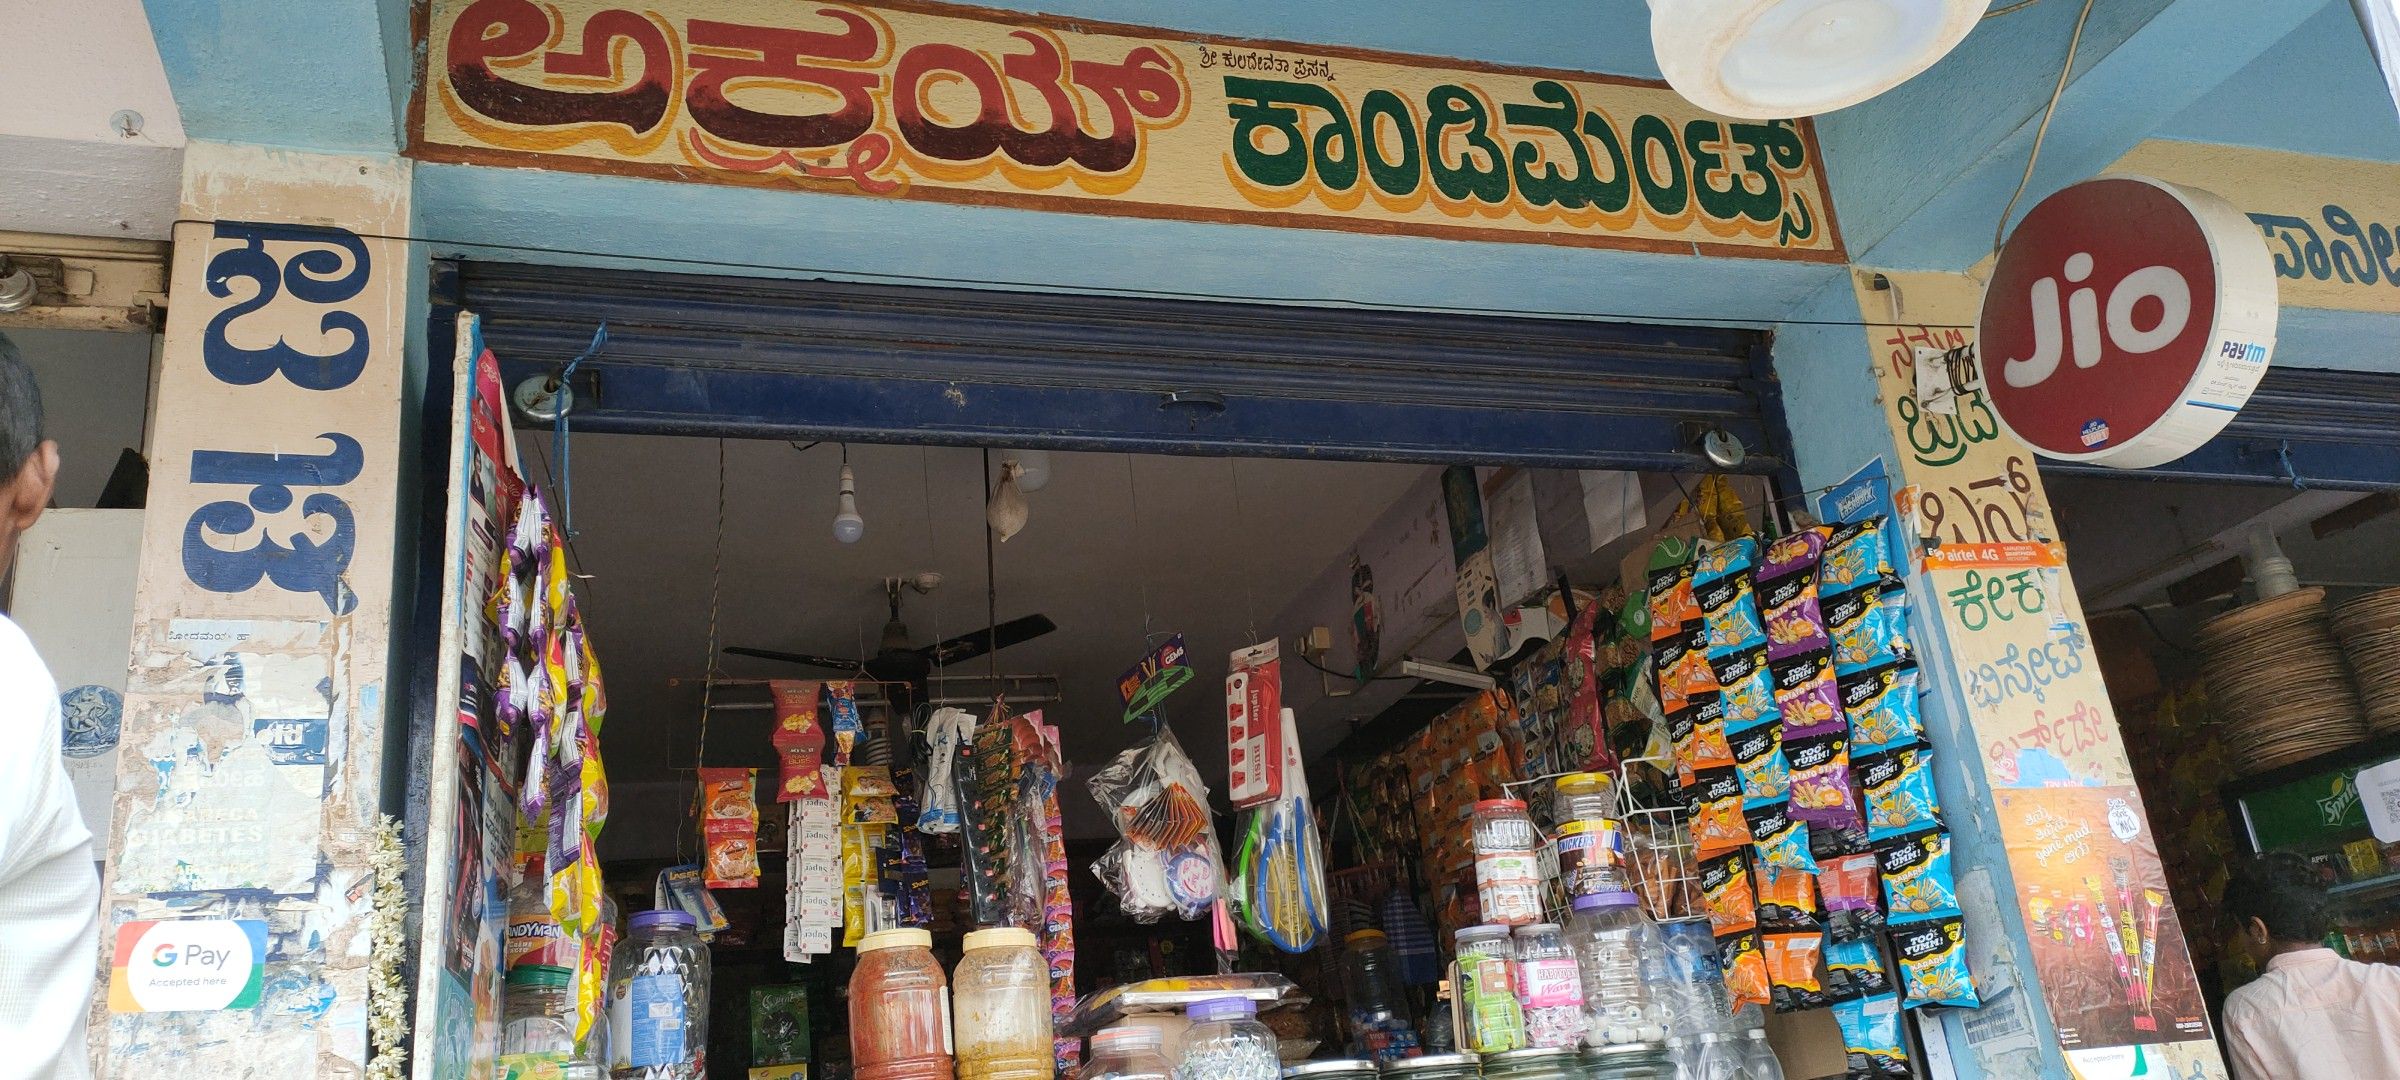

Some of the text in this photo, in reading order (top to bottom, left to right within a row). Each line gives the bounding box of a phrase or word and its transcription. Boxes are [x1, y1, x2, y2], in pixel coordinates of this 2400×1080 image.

[1199, 46, 1336, 82] ಶ್ರೀ ಕುಲದೇವತಾ ಪ್ರಸನ್ನ
[447, 0, 1182, 193] ಅಕ್ಷಯ್
[2004, 251, 2192, 389] Jio
[2220, 340, 2266, 363] paytm
[1948, 549, 1978, 561] airtel
[1982, 549, 1999, 560] 4G
[1702, 588, 1733, 610] YUMM!
[1769, 586, 1799, 607] YUMM!
[1947, 569, 2046, 631] ಕೇಕ
[1829, 603, 1860, 624] YUMM!
[1720, 662, 1752, 683] YUMM!
[1725, 658, 1745, 671] TOO
[1787, 663, 1808, 675] TOO
[1782, 666, 1816, 686] YUMM!
[1846, 682, 1879, 703] YUMM!
[1851, 681, 1871, 695] TOO
[1737, 740, 1769, 760] YUMM!
[1743, 736, 1764, 751] TOO
[1803, 746, 1822, 758] TOO
[1253, 744, 1262, 783] BUSH
[1793, 749, 1830, 767] YUMM!
[1870, 761, 1890, 775] TOO
[1864, 764, 1898, 786] YUMM!
[1755, 818, 1786, 838] YUMM!
[1758, 815, 1780, 828] TOO
[1885, 849, 1921, 871] YUMM!
[1890, 845, 1911, 859] TOO
[670, 871, 699, 880] LASER
[1904, 938, 1944, 956] YUMM!
[1909, 931, 1934, 945] TOO
[185, 945, 230, 971] Pay
[149, 978, 227, 989] Accepted here
